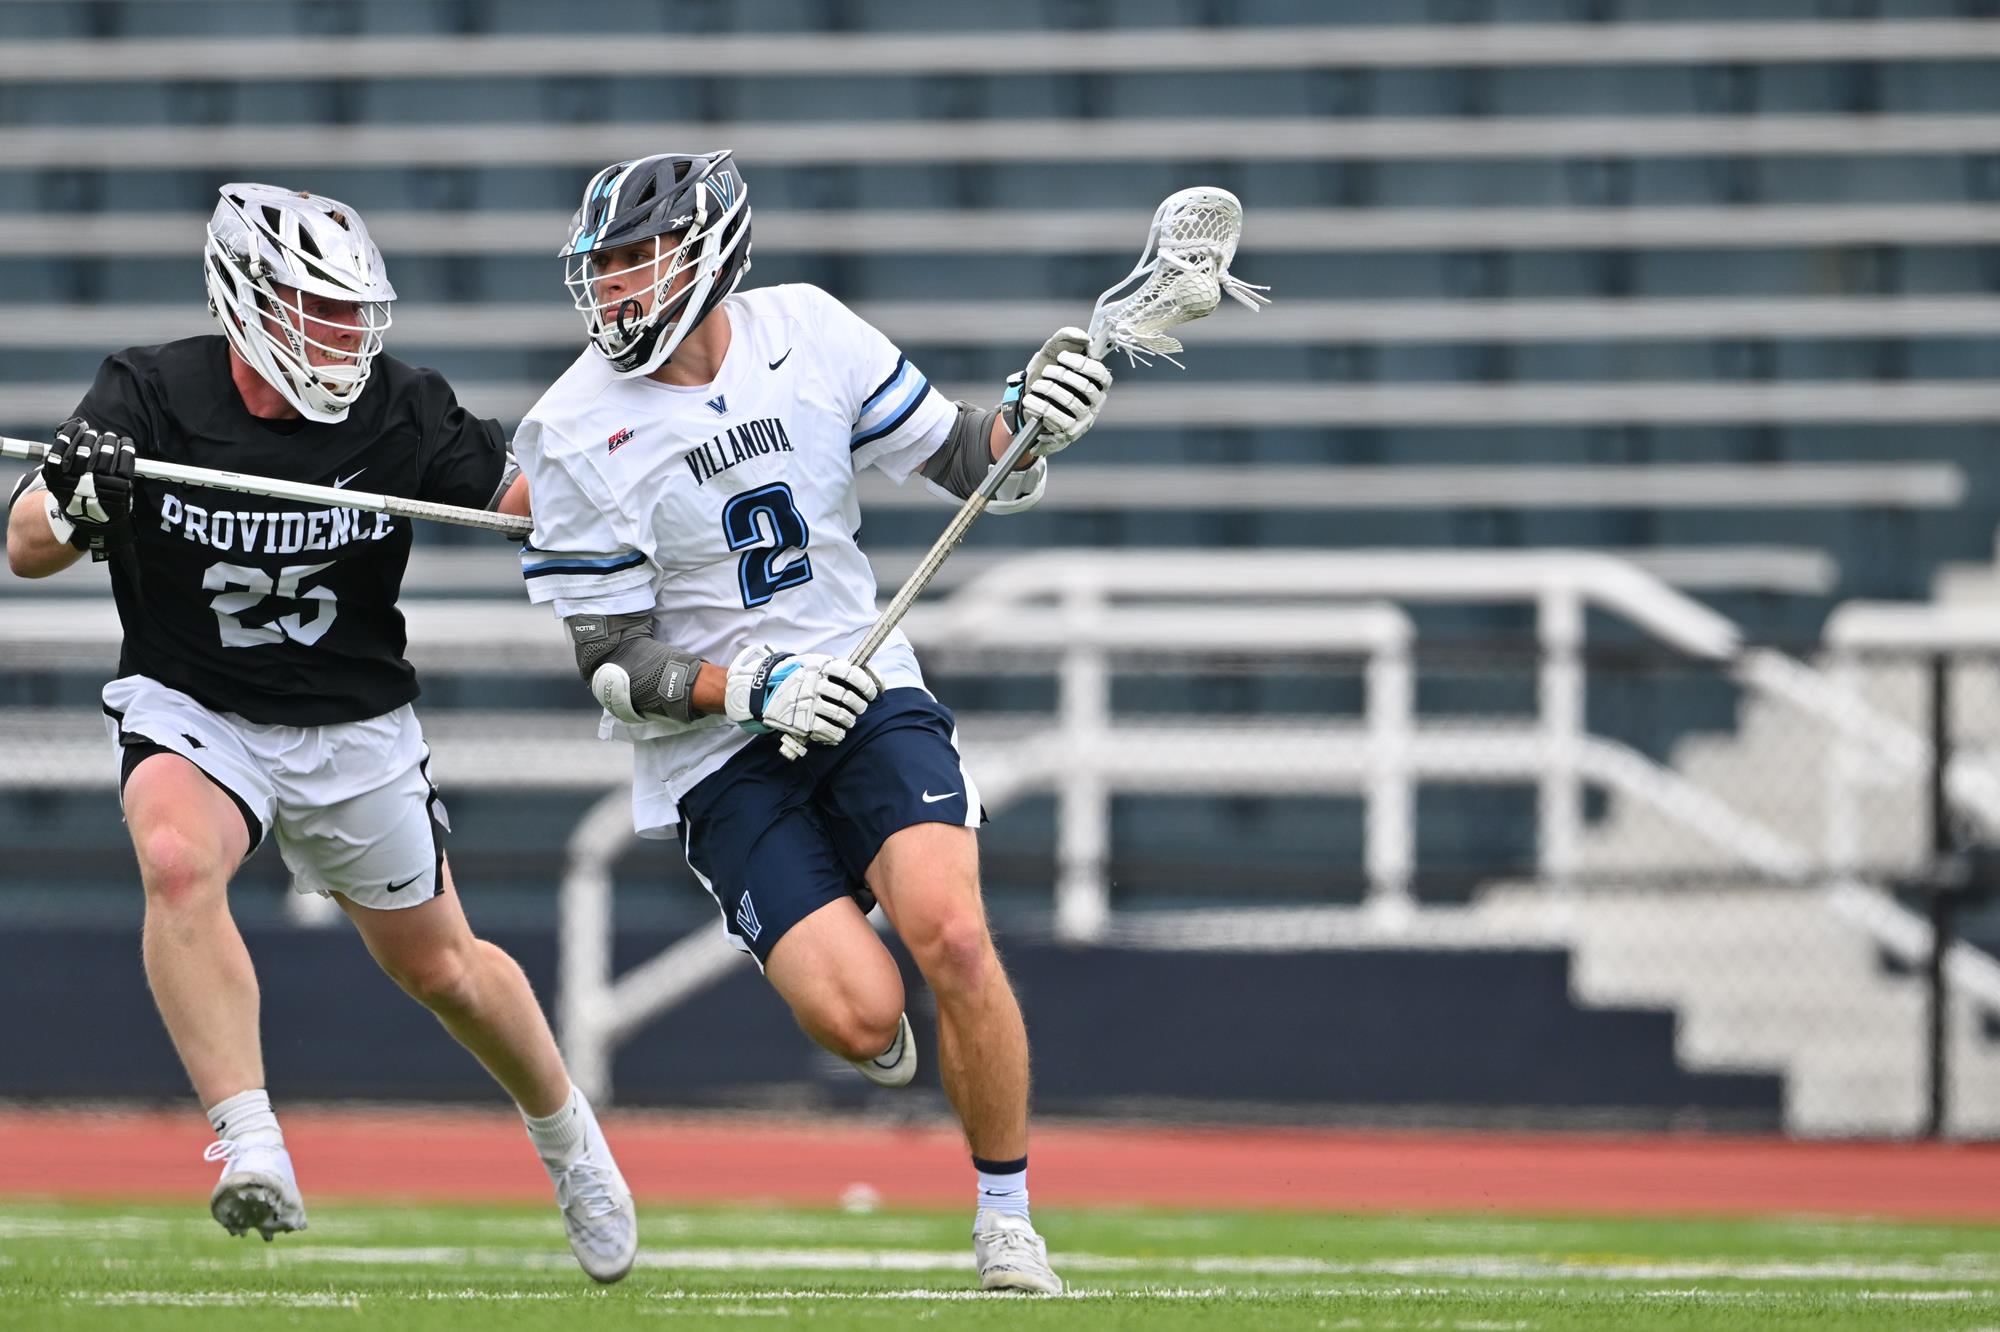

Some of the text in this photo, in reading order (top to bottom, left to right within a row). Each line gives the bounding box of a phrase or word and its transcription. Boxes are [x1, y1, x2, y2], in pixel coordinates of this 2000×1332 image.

[705, 394, 730, 417] V
[607, 427, 627, 444] BIG
[608, 429, 635, 451] EAST
[684, 417, 795, 487] VILLANOVA
[721, 481, 814, 610] 2
[202, 560, 338, 648] 25
